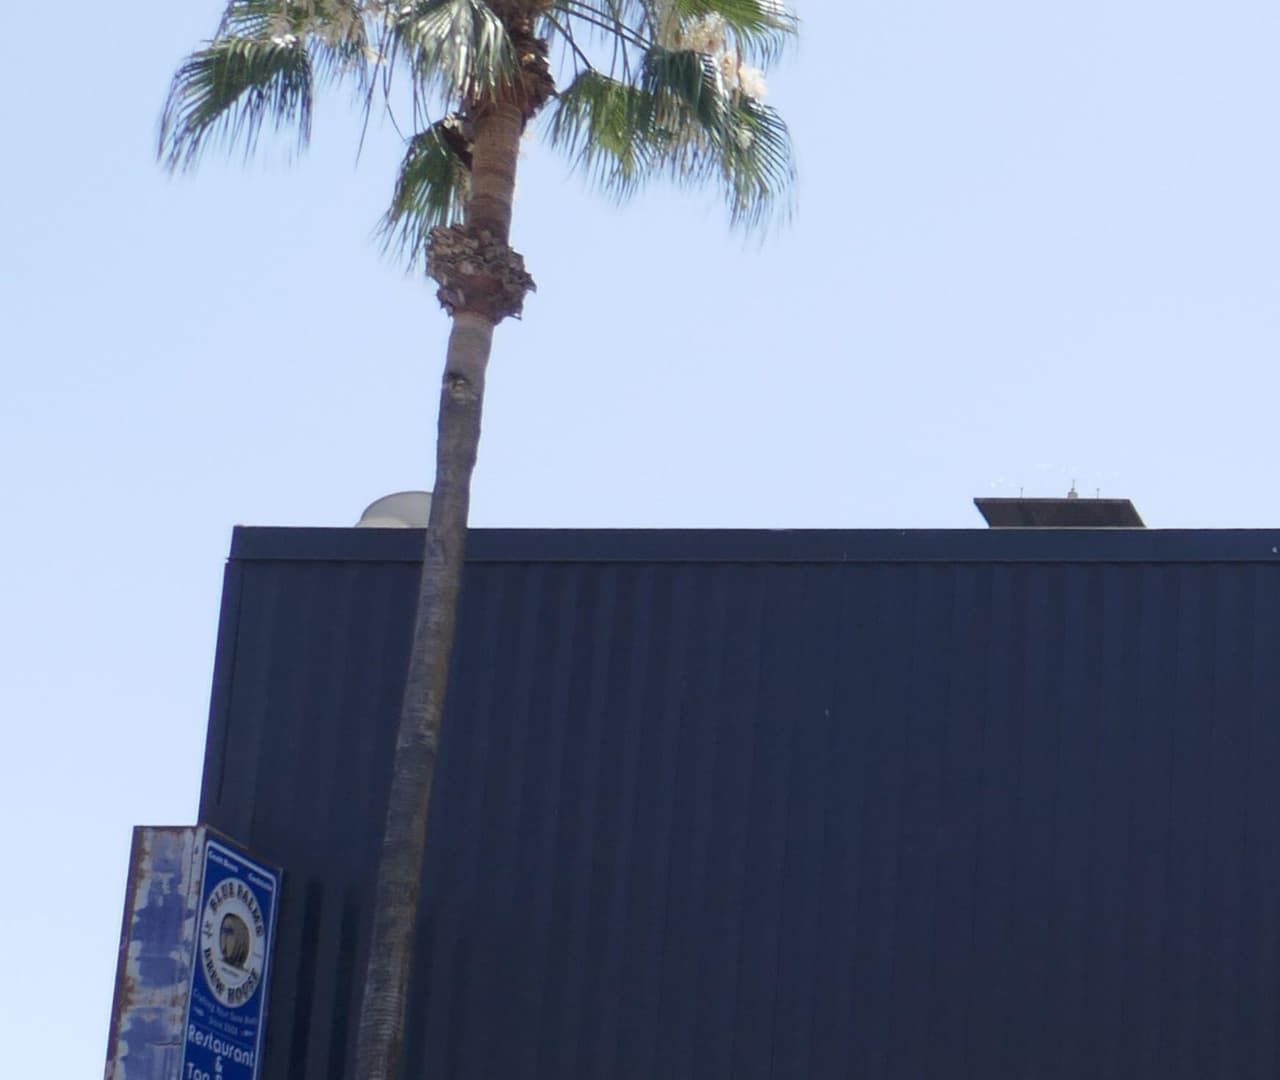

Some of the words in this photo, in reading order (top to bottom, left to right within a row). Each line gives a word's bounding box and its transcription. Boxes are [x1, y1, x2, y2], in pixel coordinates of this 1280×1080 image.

[209, 881, 235, 916] BLUE
[227, 966, 259, 1005] HOUSE
[188, 1023, 255, 1067] Restaurant
[215, 1055, 223, 1073] &
